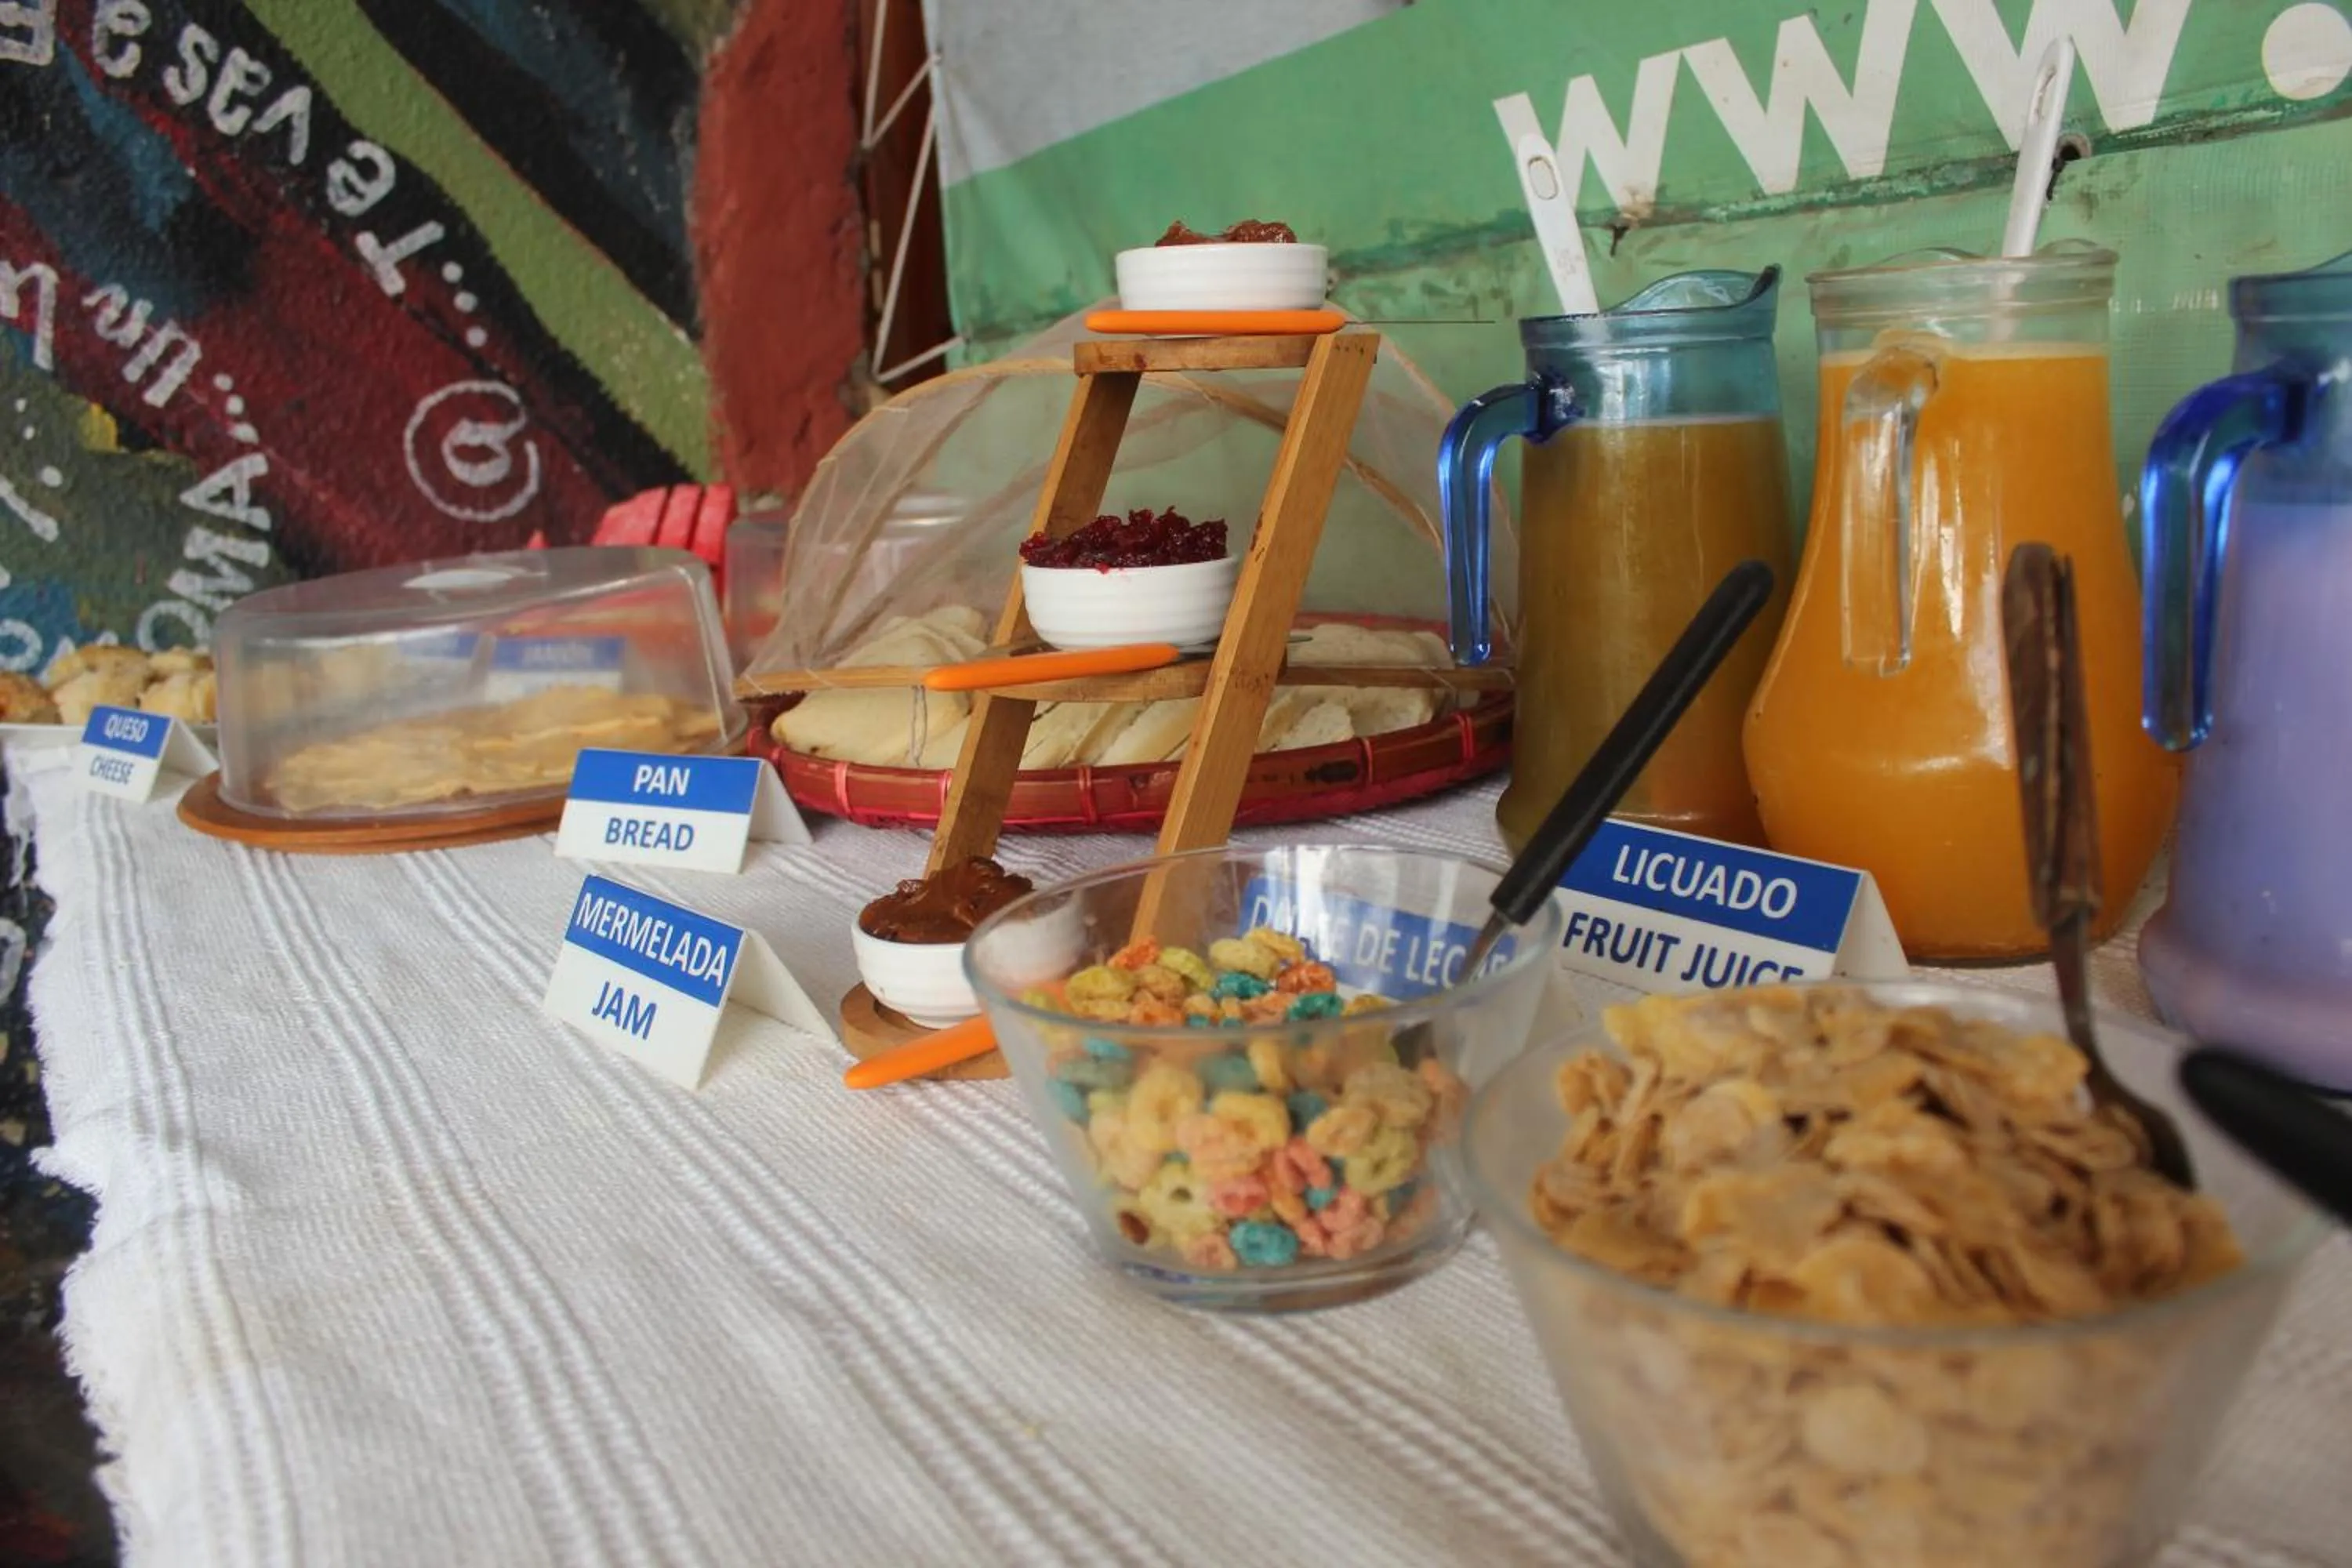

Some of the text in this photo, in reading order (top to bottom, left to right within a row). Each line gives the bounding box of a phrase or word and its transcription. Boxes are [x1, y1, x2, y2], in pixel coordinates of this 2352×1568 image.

[104, 713, 149, 742] QUESO
[90, 754, 135, 785] CHEESE
[633, 764, 691, 797] PAN
[604, 817, 695, 851] BREAD
[1612, 843, 1798, 920] LICUADO
[575, 892, 728, 988] MERMELADA
[1356, 922, 1403, 975] DE
[1406, 935, 1508, 989] LEC
[1562, 911, 1681, 974] FRUIT
[591, 980, 658, 1040] JAM
